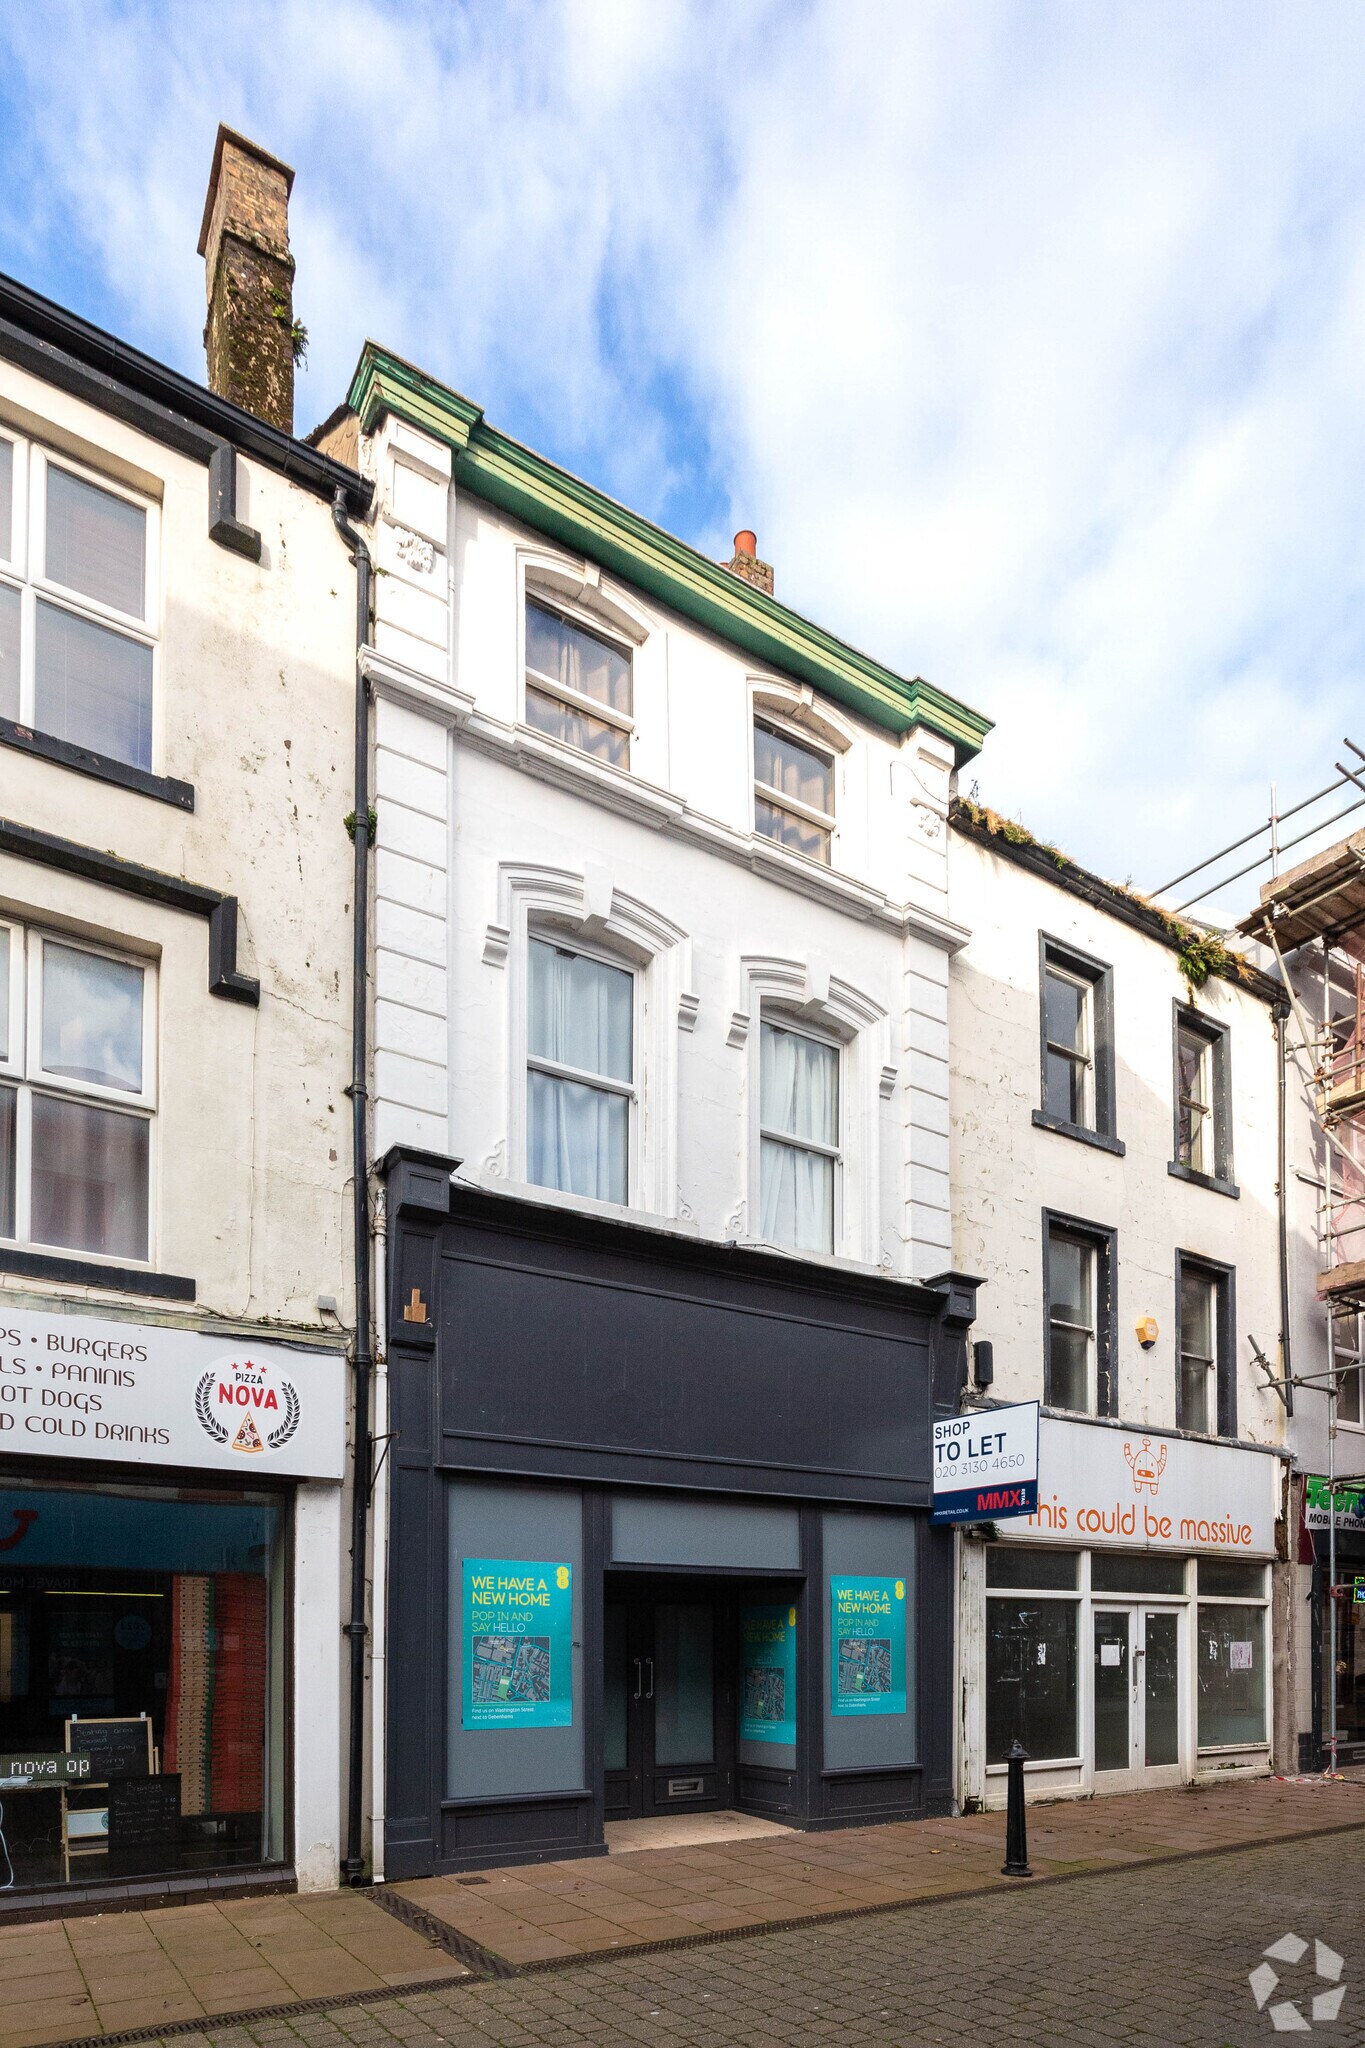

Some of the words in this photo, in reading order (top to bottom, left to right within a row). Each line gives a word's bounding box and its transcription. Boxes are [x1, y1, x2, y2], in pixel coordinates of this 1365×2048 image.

[47, 1333, 148, 1362] BURGERS
[51, 1362, 136, 1388] PANINIS
[235, 1372, 264, 1385] PIZZA
[41, 1388, 103, 1414] DOGS
[218, 1382, 279, 1410] NOVA
[24, 1415, 86, 1437] COLD
[95, 1421, 171, 1445] DRINKS
[934, 1421, 971, 1440] SHOP
[934, 1441, 961, 1463] TO
[968, 1432, 1007, 1458] LET
[934, 1464, 958, 1479] 020
[961, 1459, 988, 1475] 3130
[991, 1454, 1025, 1470] 4650
[976, 1489, 1021, 1511] MMX
[1028, 1493, 1068, 1530] his
[1076, 1502, 1136, 1536] could
[1144, 1505, 1172, 1539] be
[1180, 1513, 1252, 1546] massive
[1308, 1513, 1341, 1526] MOBIE
[471, 1575, 495, 1590] WE
[497, 1577, 535, 1591] HAVE
[537, 1578, 548, 1592] A
[471, 1591, 506, 1605] NEW
[508, 1593, 551, 1607] HOME
[837, 1589, 854, 1601] WE
[854, 1590, 880, 1601] HAVE
[881, 1590, 890, 1602] A
[471, 1610, 495, 1621] POP
[497, 1611, 509, 1621] IN
[511, 1611, 534, 1622] AND
[837, 1602, 861, 1614] NEW
[862, 1603, 892, 1614] HOME
[471, 1622, 491, 1632] SAY
[493, 1622, 526, 1633] HELLO
[837, 1618, 854, 1627] POP
[855, 1618, 863, 1627] IN
[864, 1618, 880, 1628] AND
[837, 1628, 851, 1636] SAY
[852, 1627, 875, 1636] HELLO
[11, 1759, 57, 1775] nova
[66, 1758, 90, 1777] op
